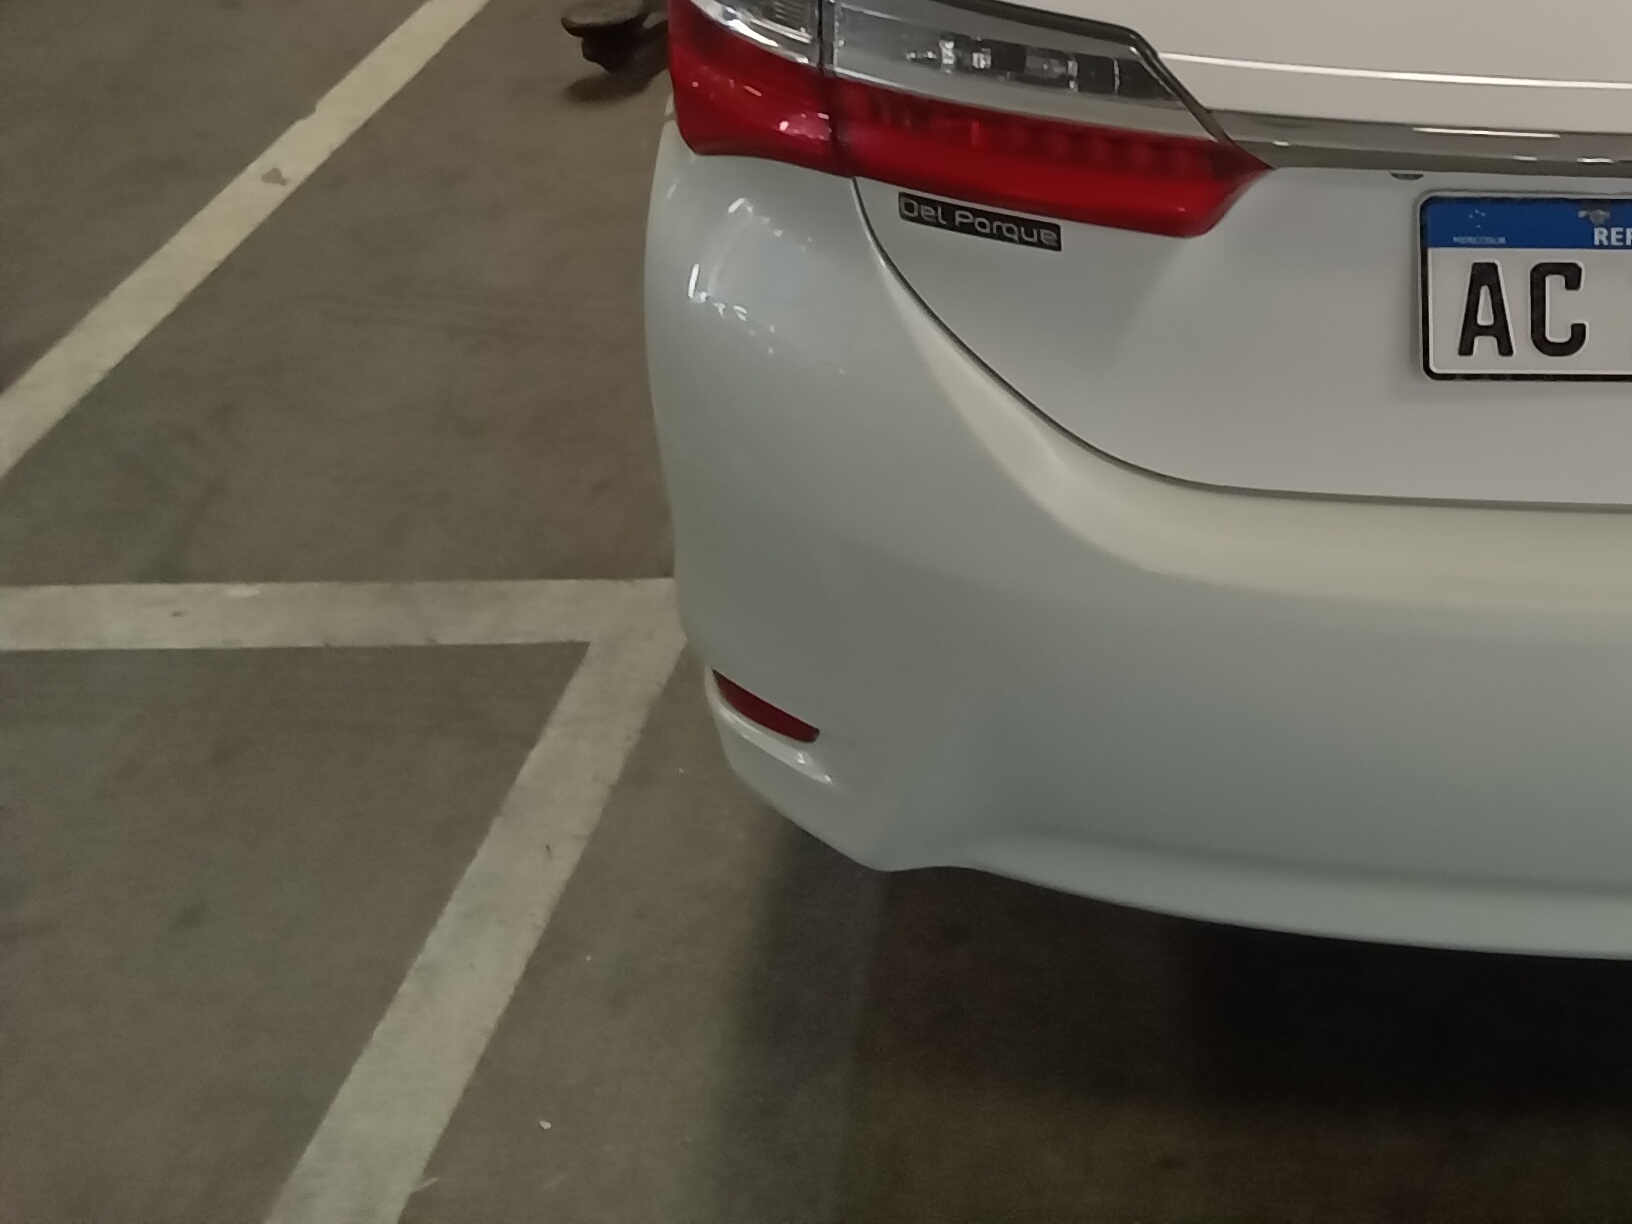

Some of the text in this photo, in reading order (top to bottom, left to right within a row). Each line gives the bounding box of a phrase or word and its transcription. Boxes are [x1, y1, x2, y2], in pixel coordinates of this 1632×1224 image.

[901, 196, 1059, 245] Del Parque
[1457, 261, 1588, 358] AC
